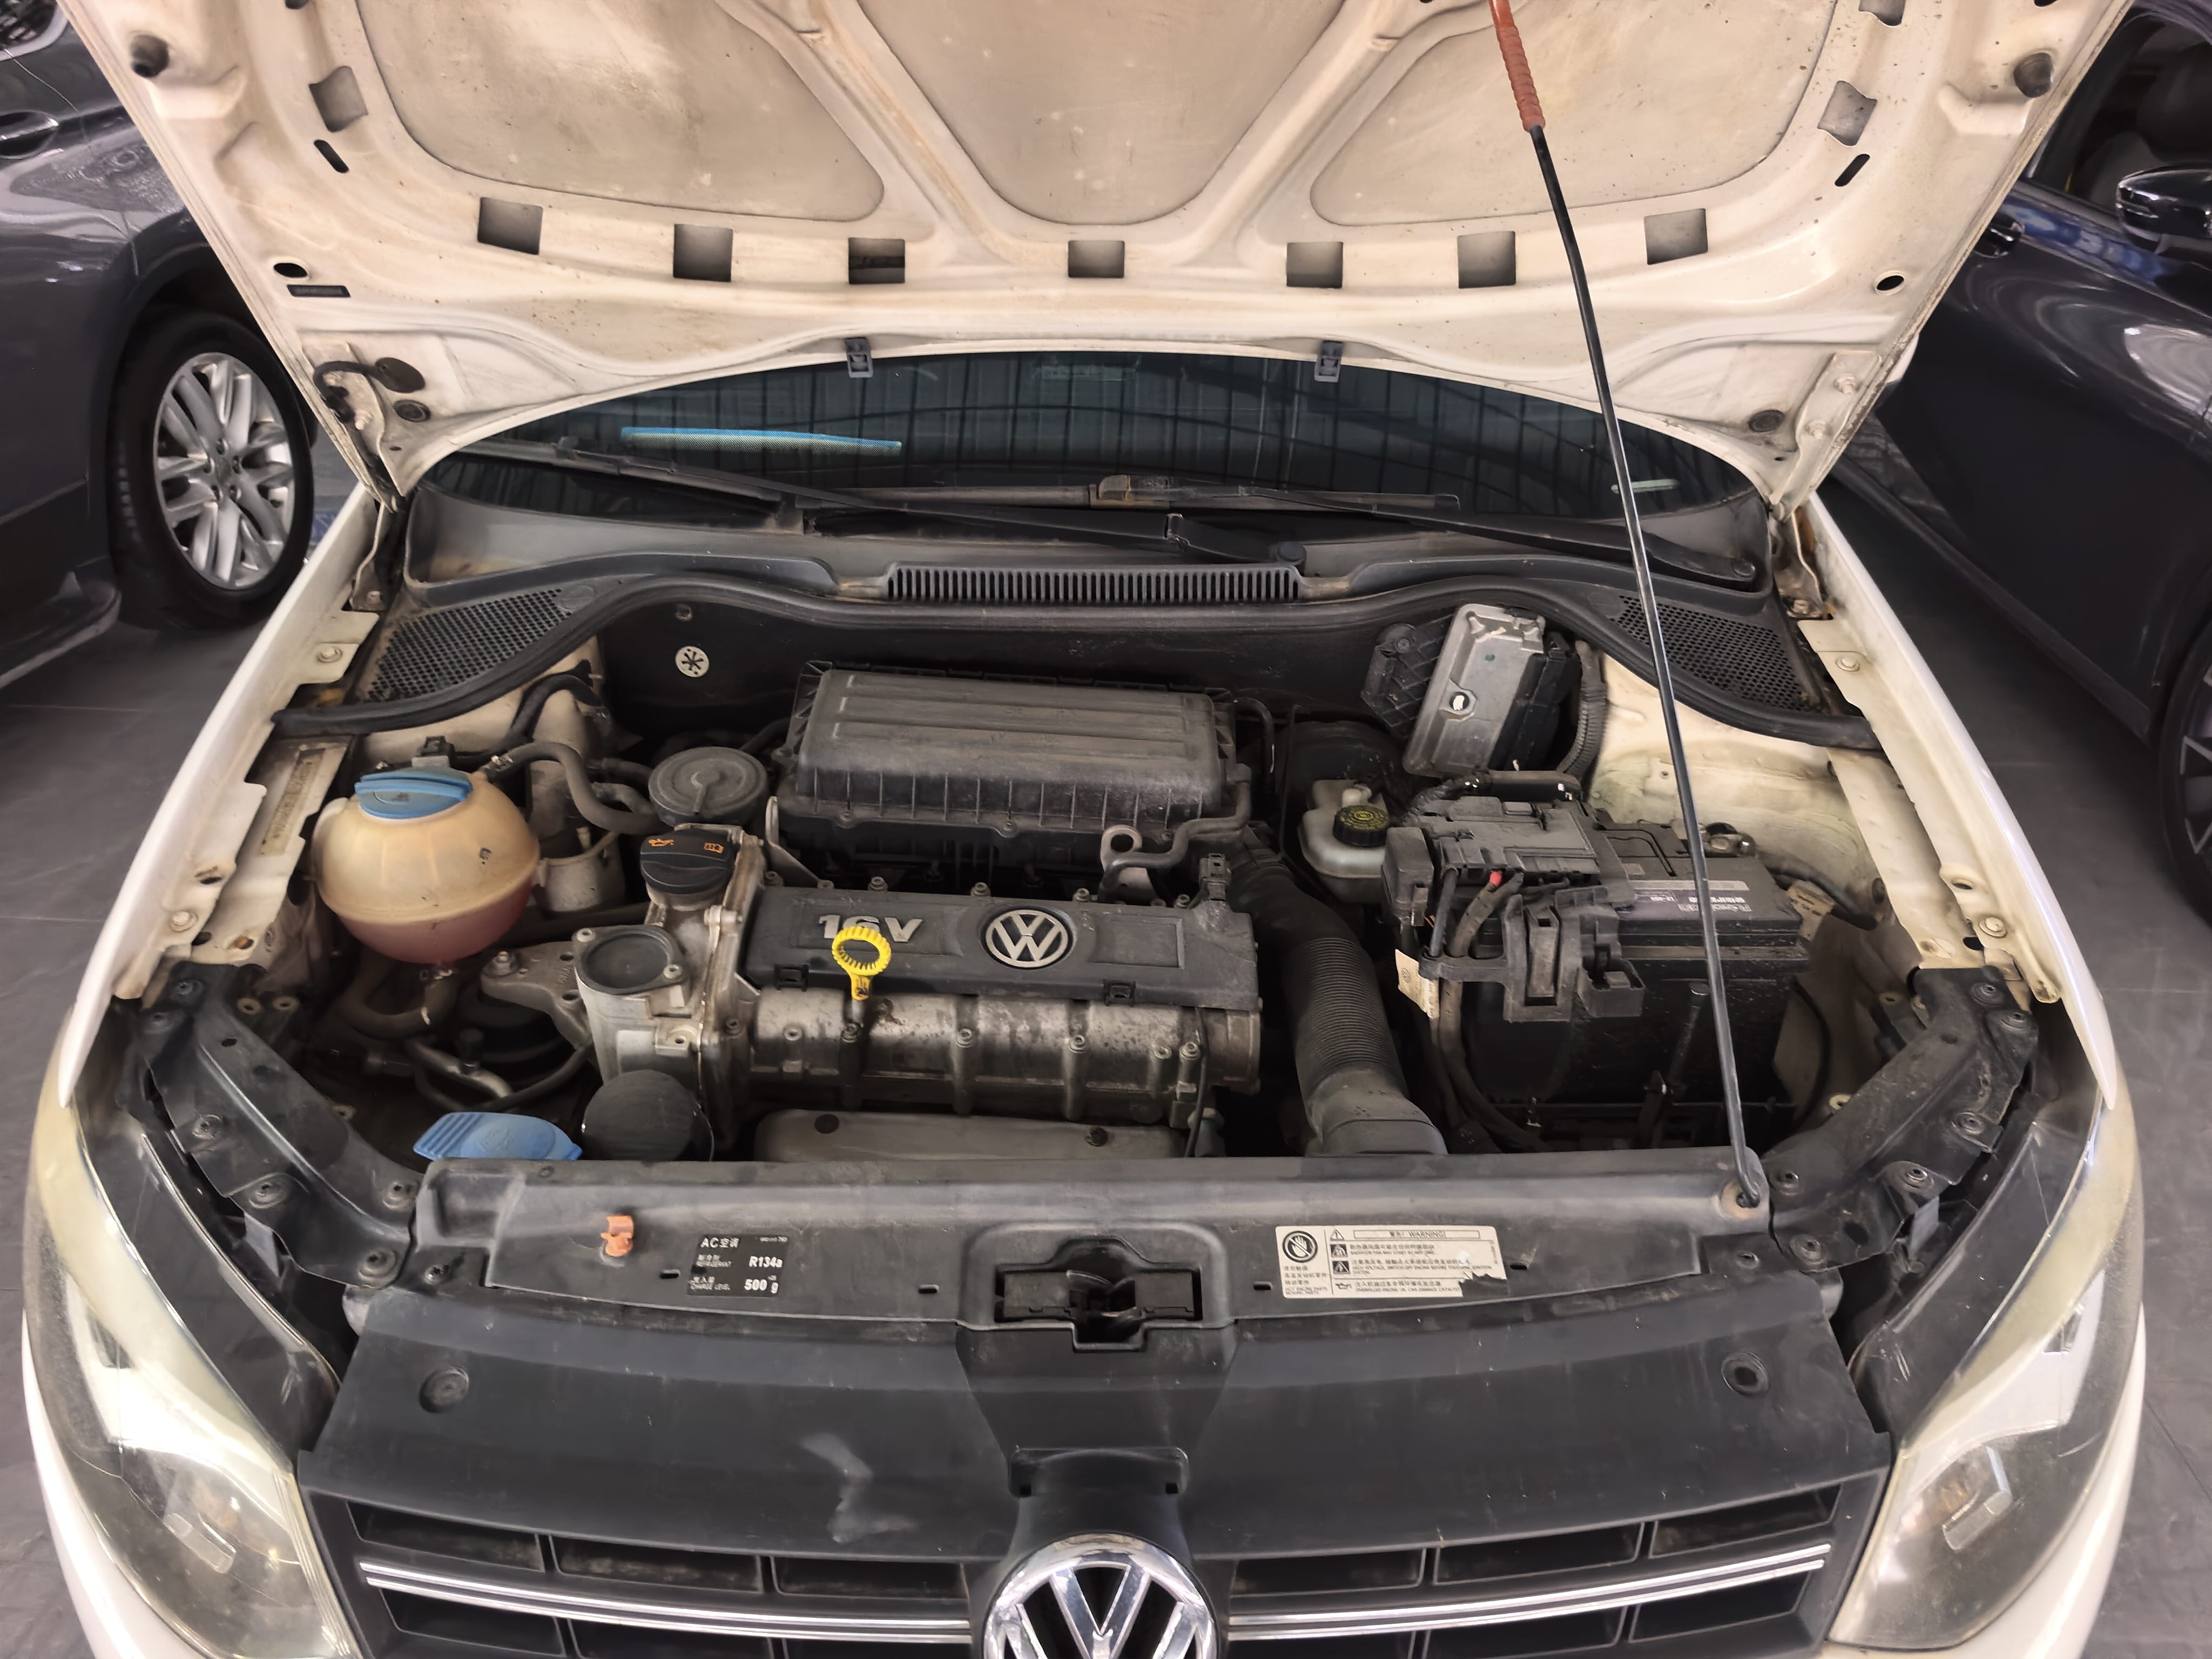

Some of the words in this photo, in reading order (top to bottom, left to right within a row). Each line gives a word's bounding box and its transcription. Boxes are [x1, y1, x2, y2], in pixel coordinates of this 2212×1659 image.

[748, 1256, 783, 1267] R134a
[744, 1279, 767, 1291] 500
[771, 1282, 779, 1294] g
